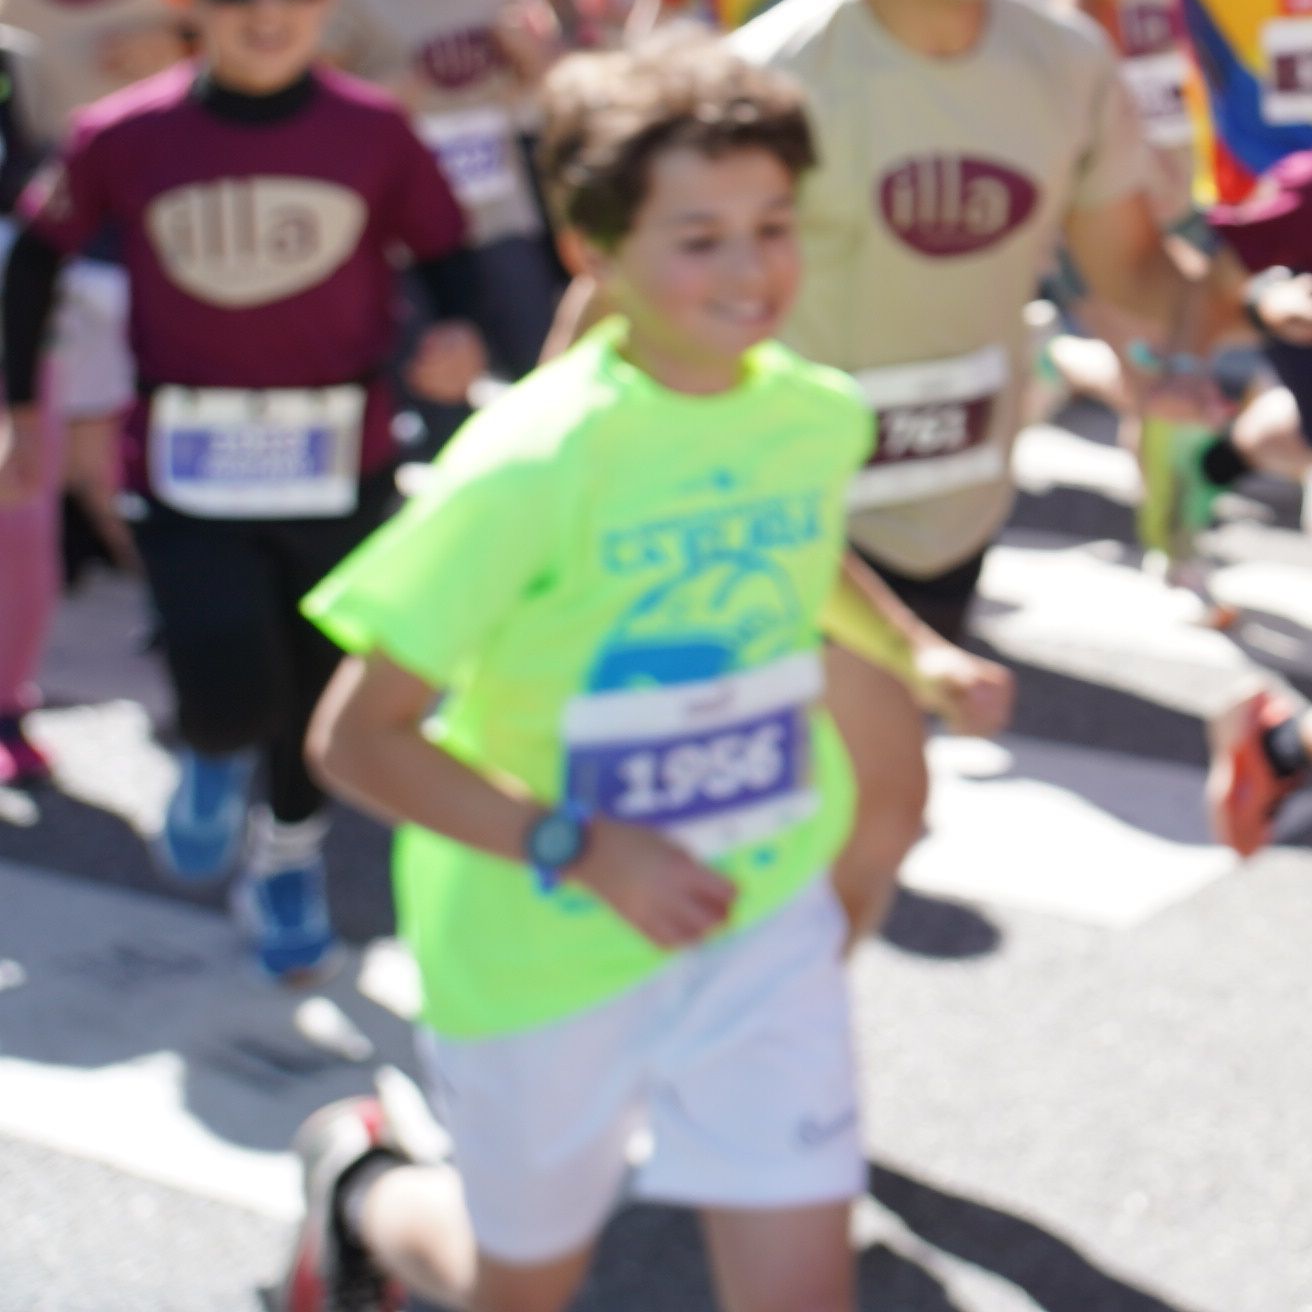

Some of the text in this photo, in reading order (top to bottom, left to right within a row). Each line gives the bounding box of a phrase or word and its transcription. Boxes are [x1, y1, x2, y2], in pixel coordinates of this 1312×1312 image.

[170, 181, 322, 266] illa
[891, 160, 1010, 234] illa
[614, 723, 786, 811] 1956
